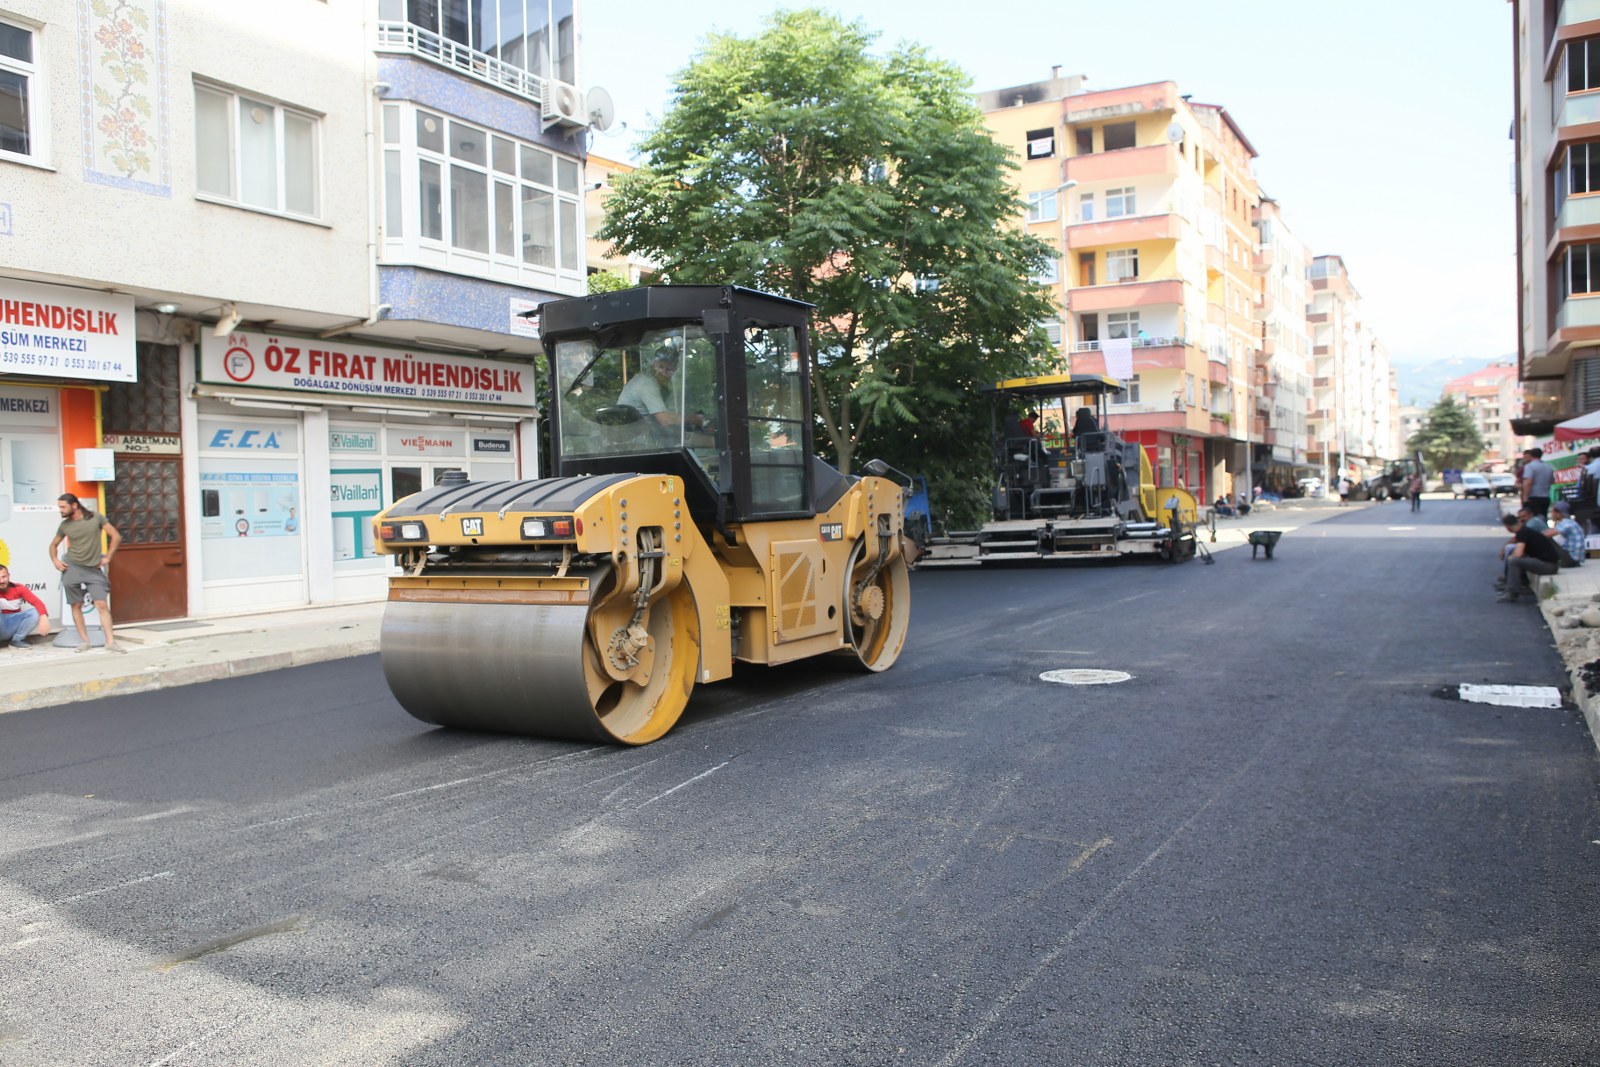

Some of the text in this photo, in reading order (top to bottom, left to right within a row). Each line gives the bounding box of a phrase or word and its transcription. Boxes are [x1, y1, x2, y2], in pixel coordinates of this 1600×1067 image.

[33, 334, 87, 352] MERKEZİ
[3, 351, 19, 363] 539
[21, 353, 36, 365] 555
[38, 355, 48, 366] 97
[50, 356, 59, 367] 21
[65, 358, 70, 368] 0
[72, 358, 85, 370] 553
[88, 360, 100, 371] 301
[113, 362, 122, 372] 44
[264, 337, 301, 374] ÖZ
[308, 349, 377, 381] FIRAT
[294, 377, 340, 390] DOĞALGAZ
[342, 381, 382, 394] DÖNÜŞÜM
[384, 384, 417, 396] MERKEZİ
[426, 388, 436, 397] 539
[122, 436, 178, 446] APARTMANI
[340, 434, 374, 448] Vaillant
[401, 436, 453, 452] VIESSMANN
[478, 441, 506, 449] Buderus
[340, 484, 379, 500] Vaillant
[462, 519, 481, 535] CAT
[831, 524, 842, 539] CAT
